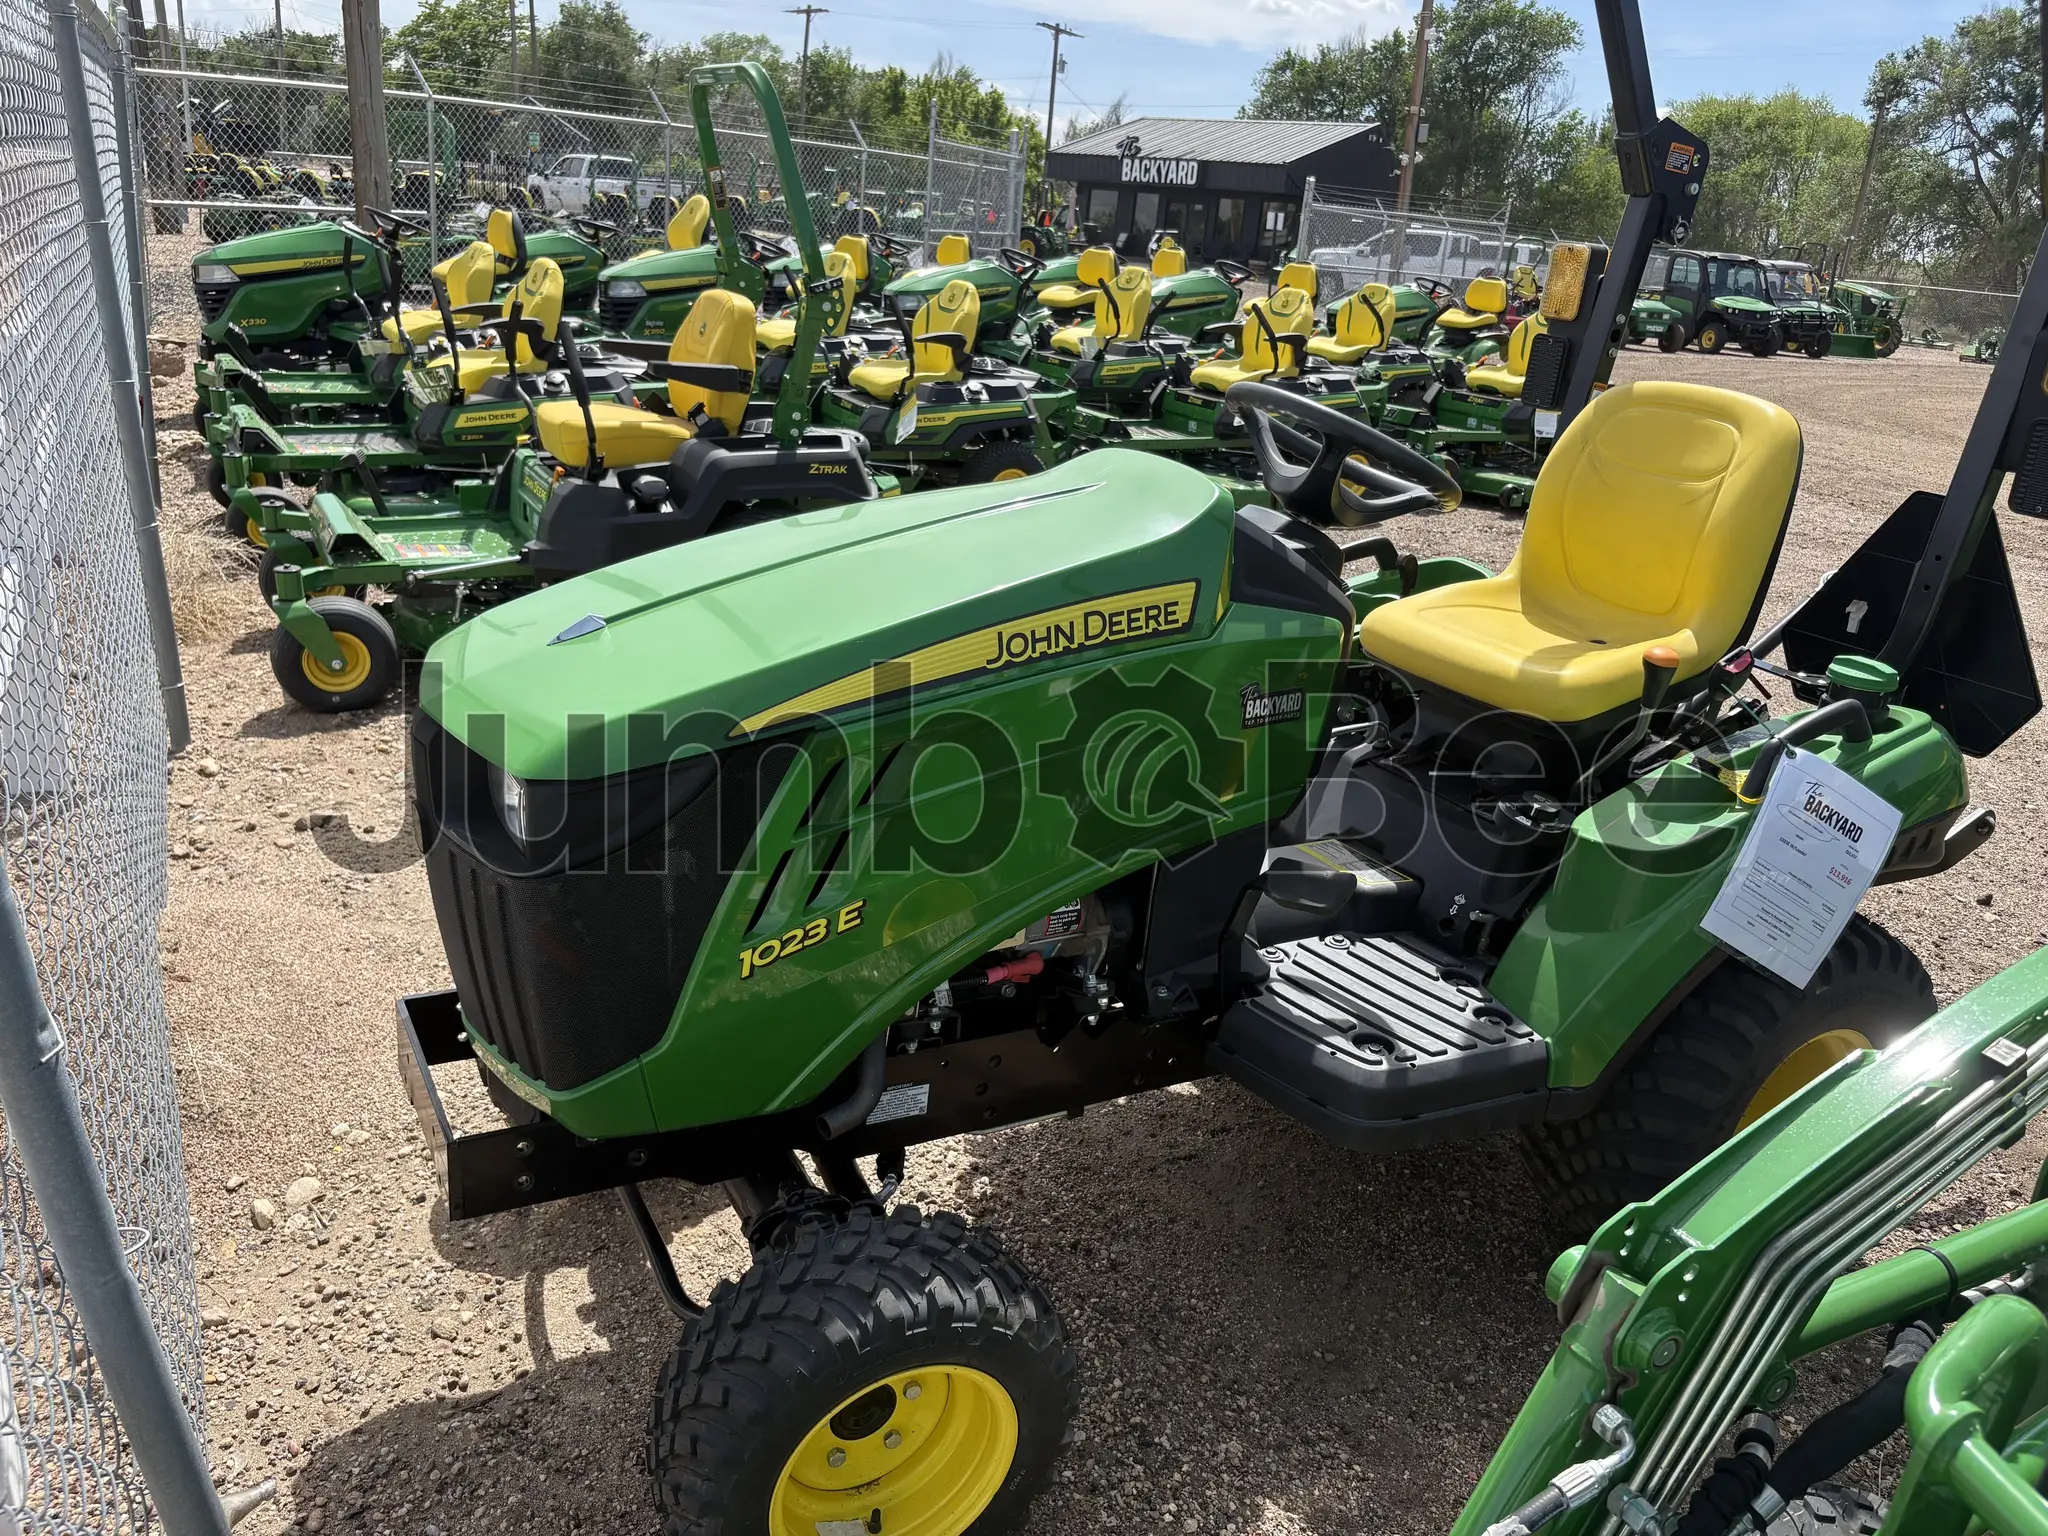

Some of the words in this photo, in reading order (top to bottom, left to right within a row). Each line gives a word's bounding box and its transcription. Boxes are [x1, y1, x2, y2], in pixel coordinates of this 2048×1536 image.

[1116, 136, 1140, 160] The
[1121, 159, 1198, 185] BACKYARD
[301, 260, 322, 269] JOHN
[240, 318, 267, 327] X330
[643, 327, 665, 336] X350
[464, 415, 488, 424] JOHN
[488, 412, 517, 421] DEERE
[808, 463, 848, 474] ZTRAK
[985, 619, 1075, 669] JOHN
[1083, 600, 1181, 644] DEERE
[1241, 684, 1260, 704] The
[1245, 693, 1302, 719] BACKYARD
[1805, 780, 1825, 798] The
[1803, 794, 1864, 844] BACKYARD
[1787, 842, 1808, 858] W/Loader
[1827, 865, 1854, 886] $13,916
[739, 917, 831, 980] 1023
[836, 898, 867, 935] E
[886, 1082, 914, 1091] IMPORTANT
